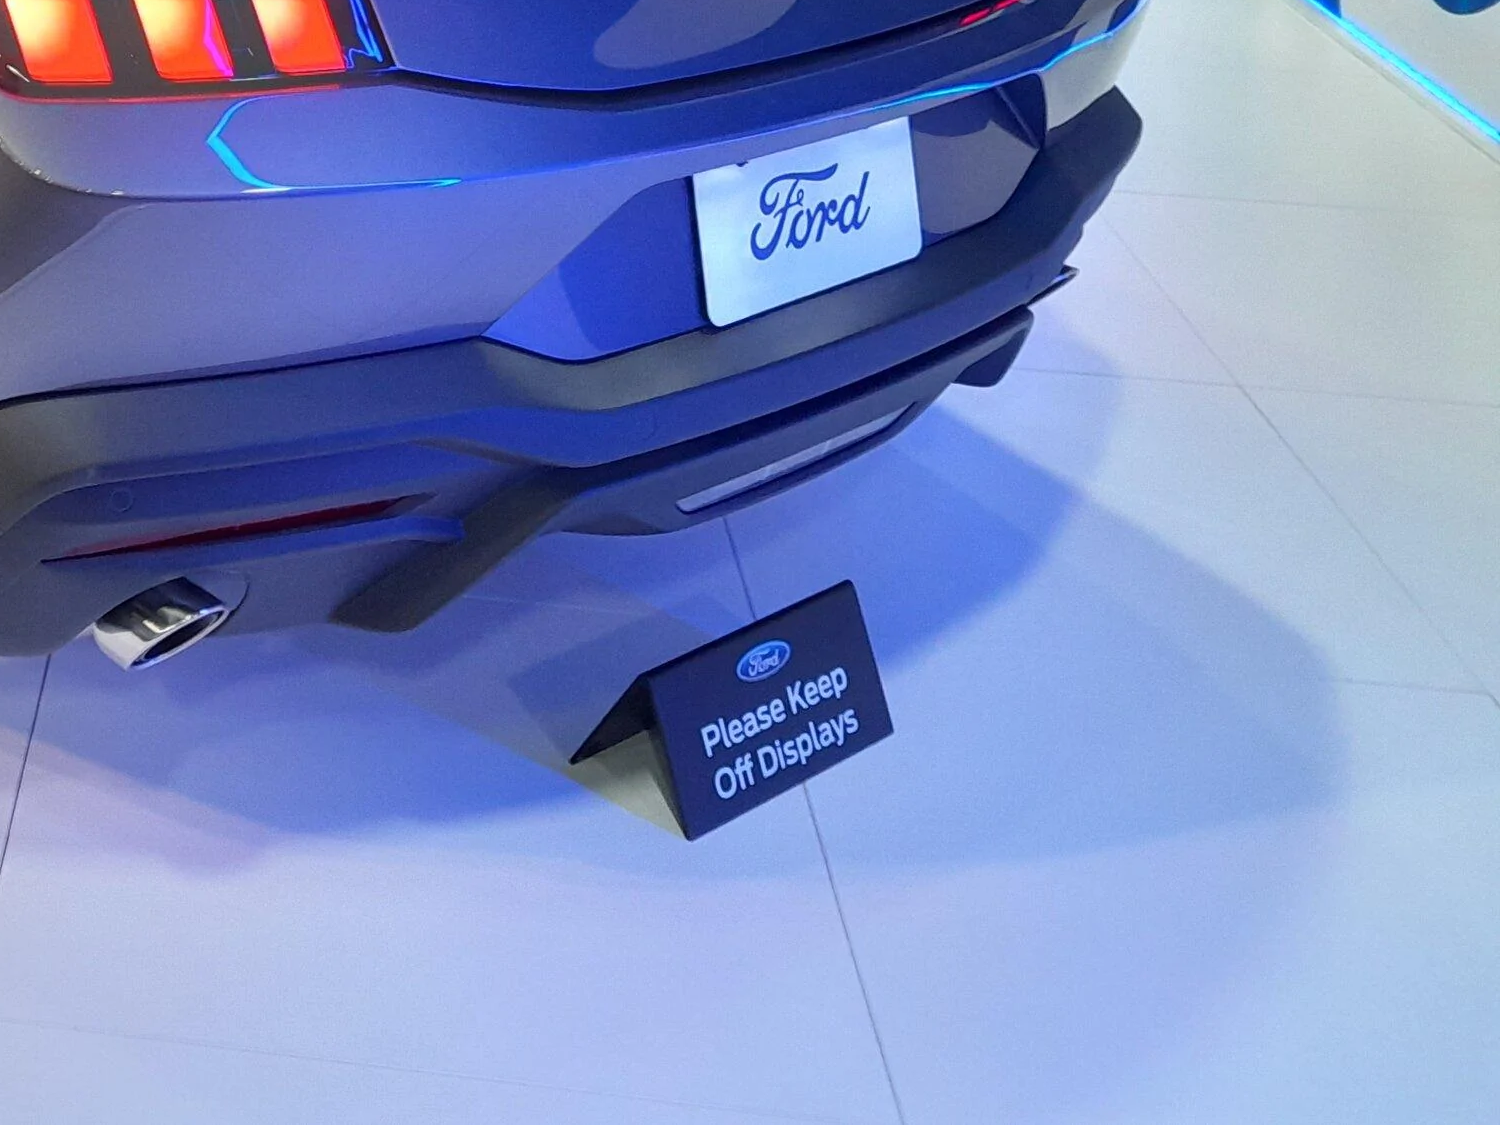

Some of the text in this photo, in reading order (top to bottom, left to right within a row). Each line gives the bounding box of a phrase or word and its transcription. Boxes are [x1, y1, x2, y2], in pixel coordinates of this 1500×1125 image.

[749, 162, 871, 261] Ford
[701, 666, 849, 758] Please Keep
[713, 709, 859, 801] Off Displays
